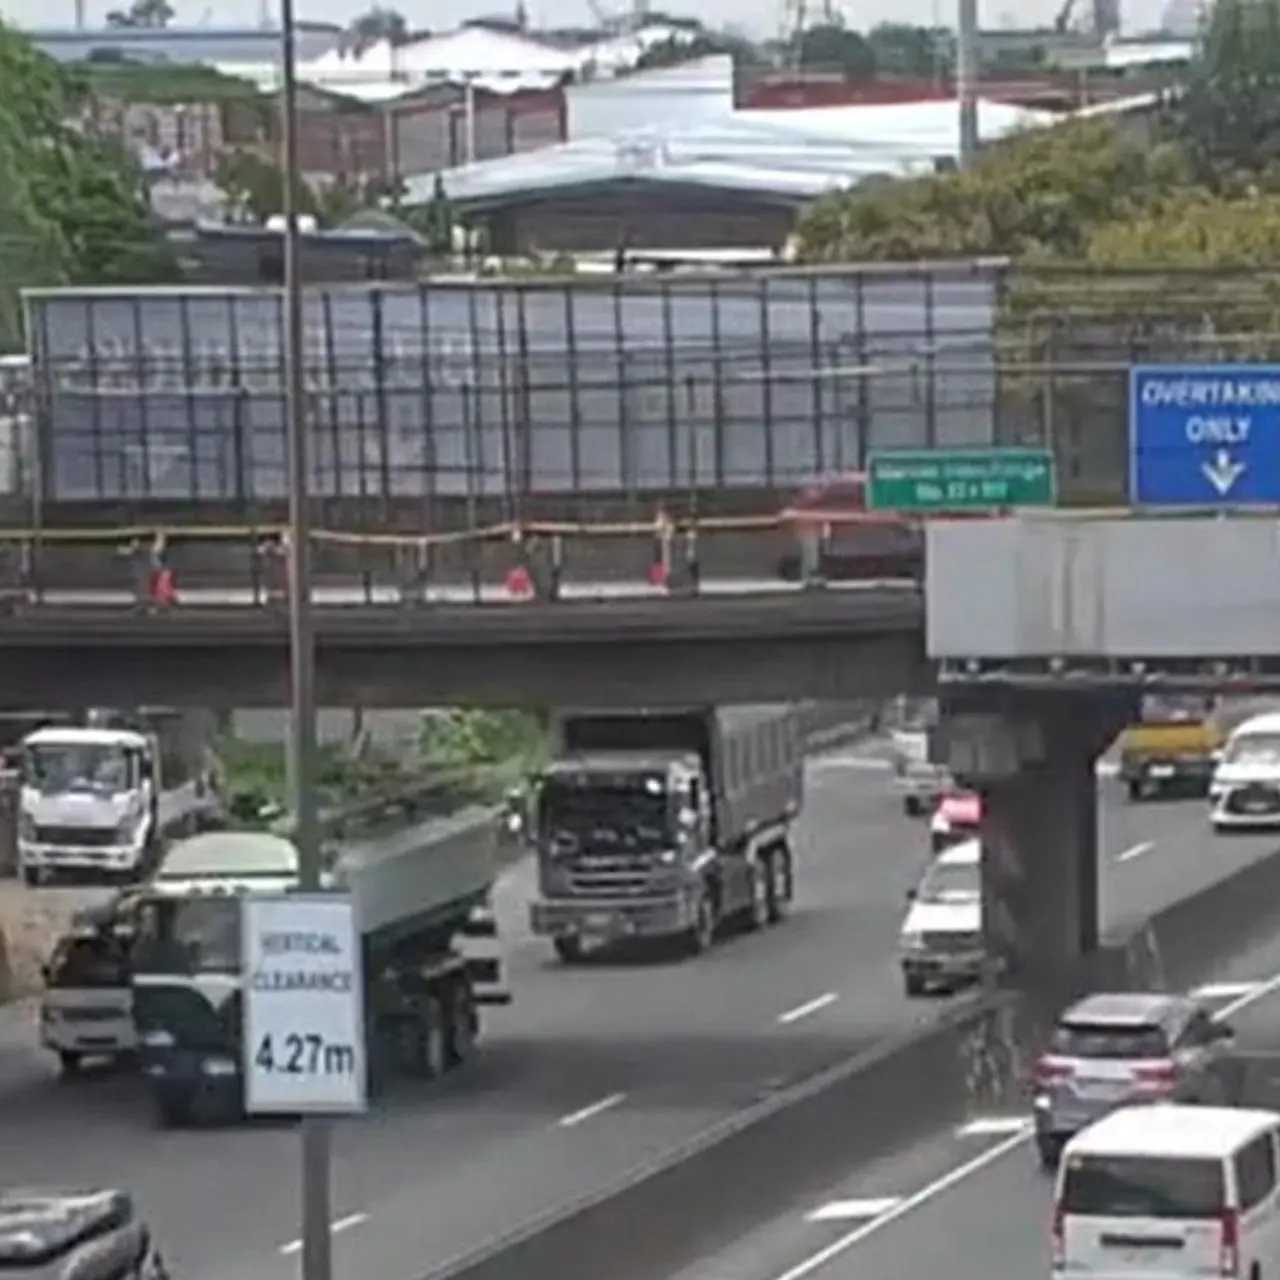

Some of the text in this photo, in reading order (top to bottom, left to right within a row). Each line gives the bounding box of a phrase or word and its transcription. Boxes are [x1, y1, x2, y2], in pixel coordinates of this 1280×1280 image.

[1186, 416, 1251, 442] ONLY
[252, 968, 353, 992] CLEARANCE
[254, 1032, 355, 1074] 4.27m
